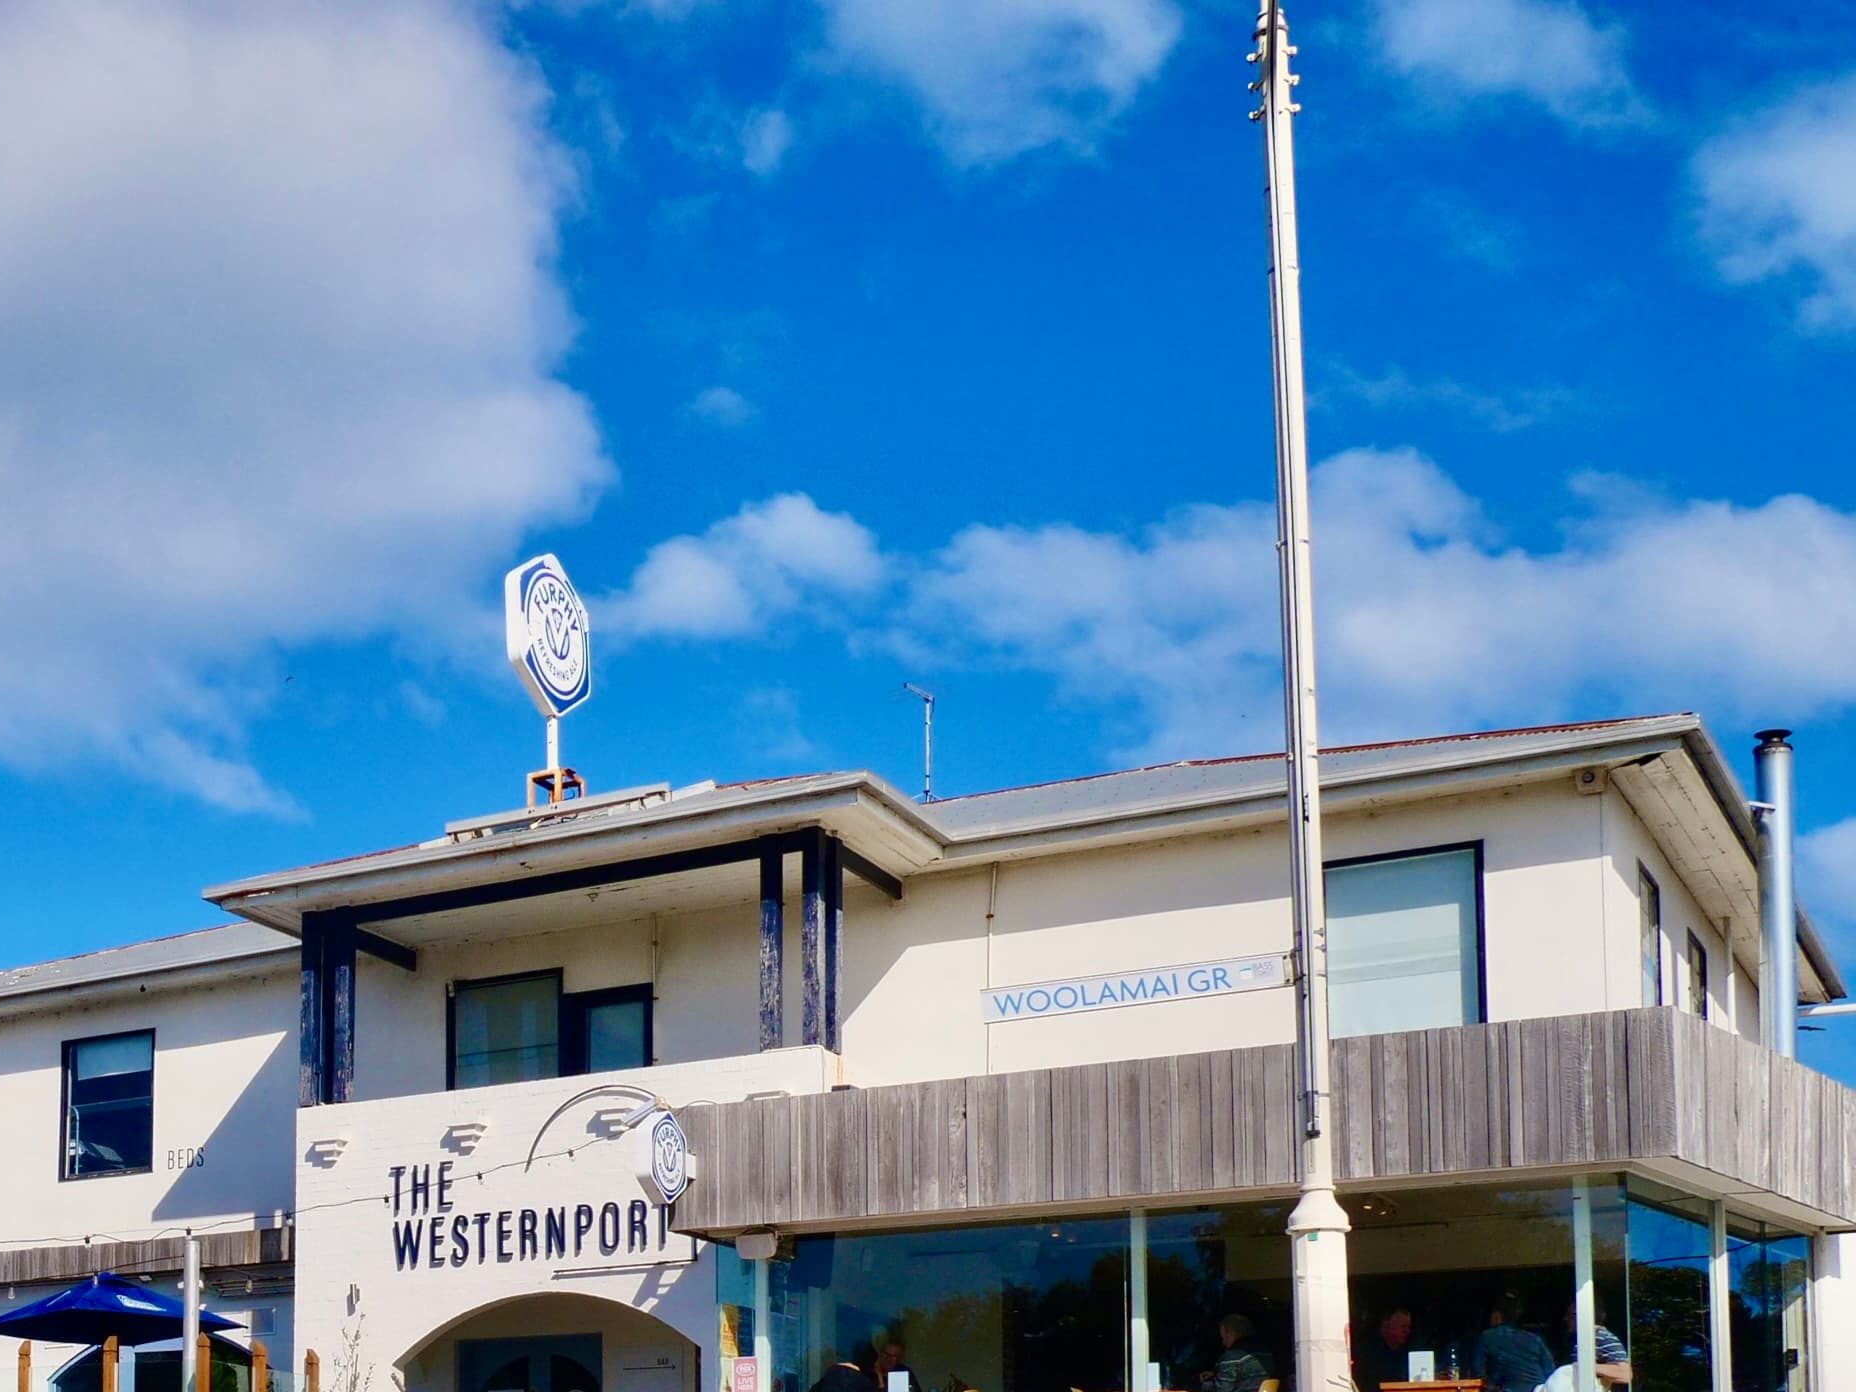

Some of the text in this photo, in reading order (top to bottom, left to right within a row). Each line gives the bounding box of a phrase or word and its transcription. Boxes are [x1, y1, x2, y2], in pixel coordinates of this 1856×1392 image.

[534, 582, 579, 632] FURPHY
[992, 967, 1233, 1016] WOOLAMAI GR
[167, 1146, 205, 1170] BEDS
[656, 1126, 682, 1153] FURPHY
[389, 1160, 454, 1212] THE
[393, 1199, 669, 1267] WESTERNPORT
